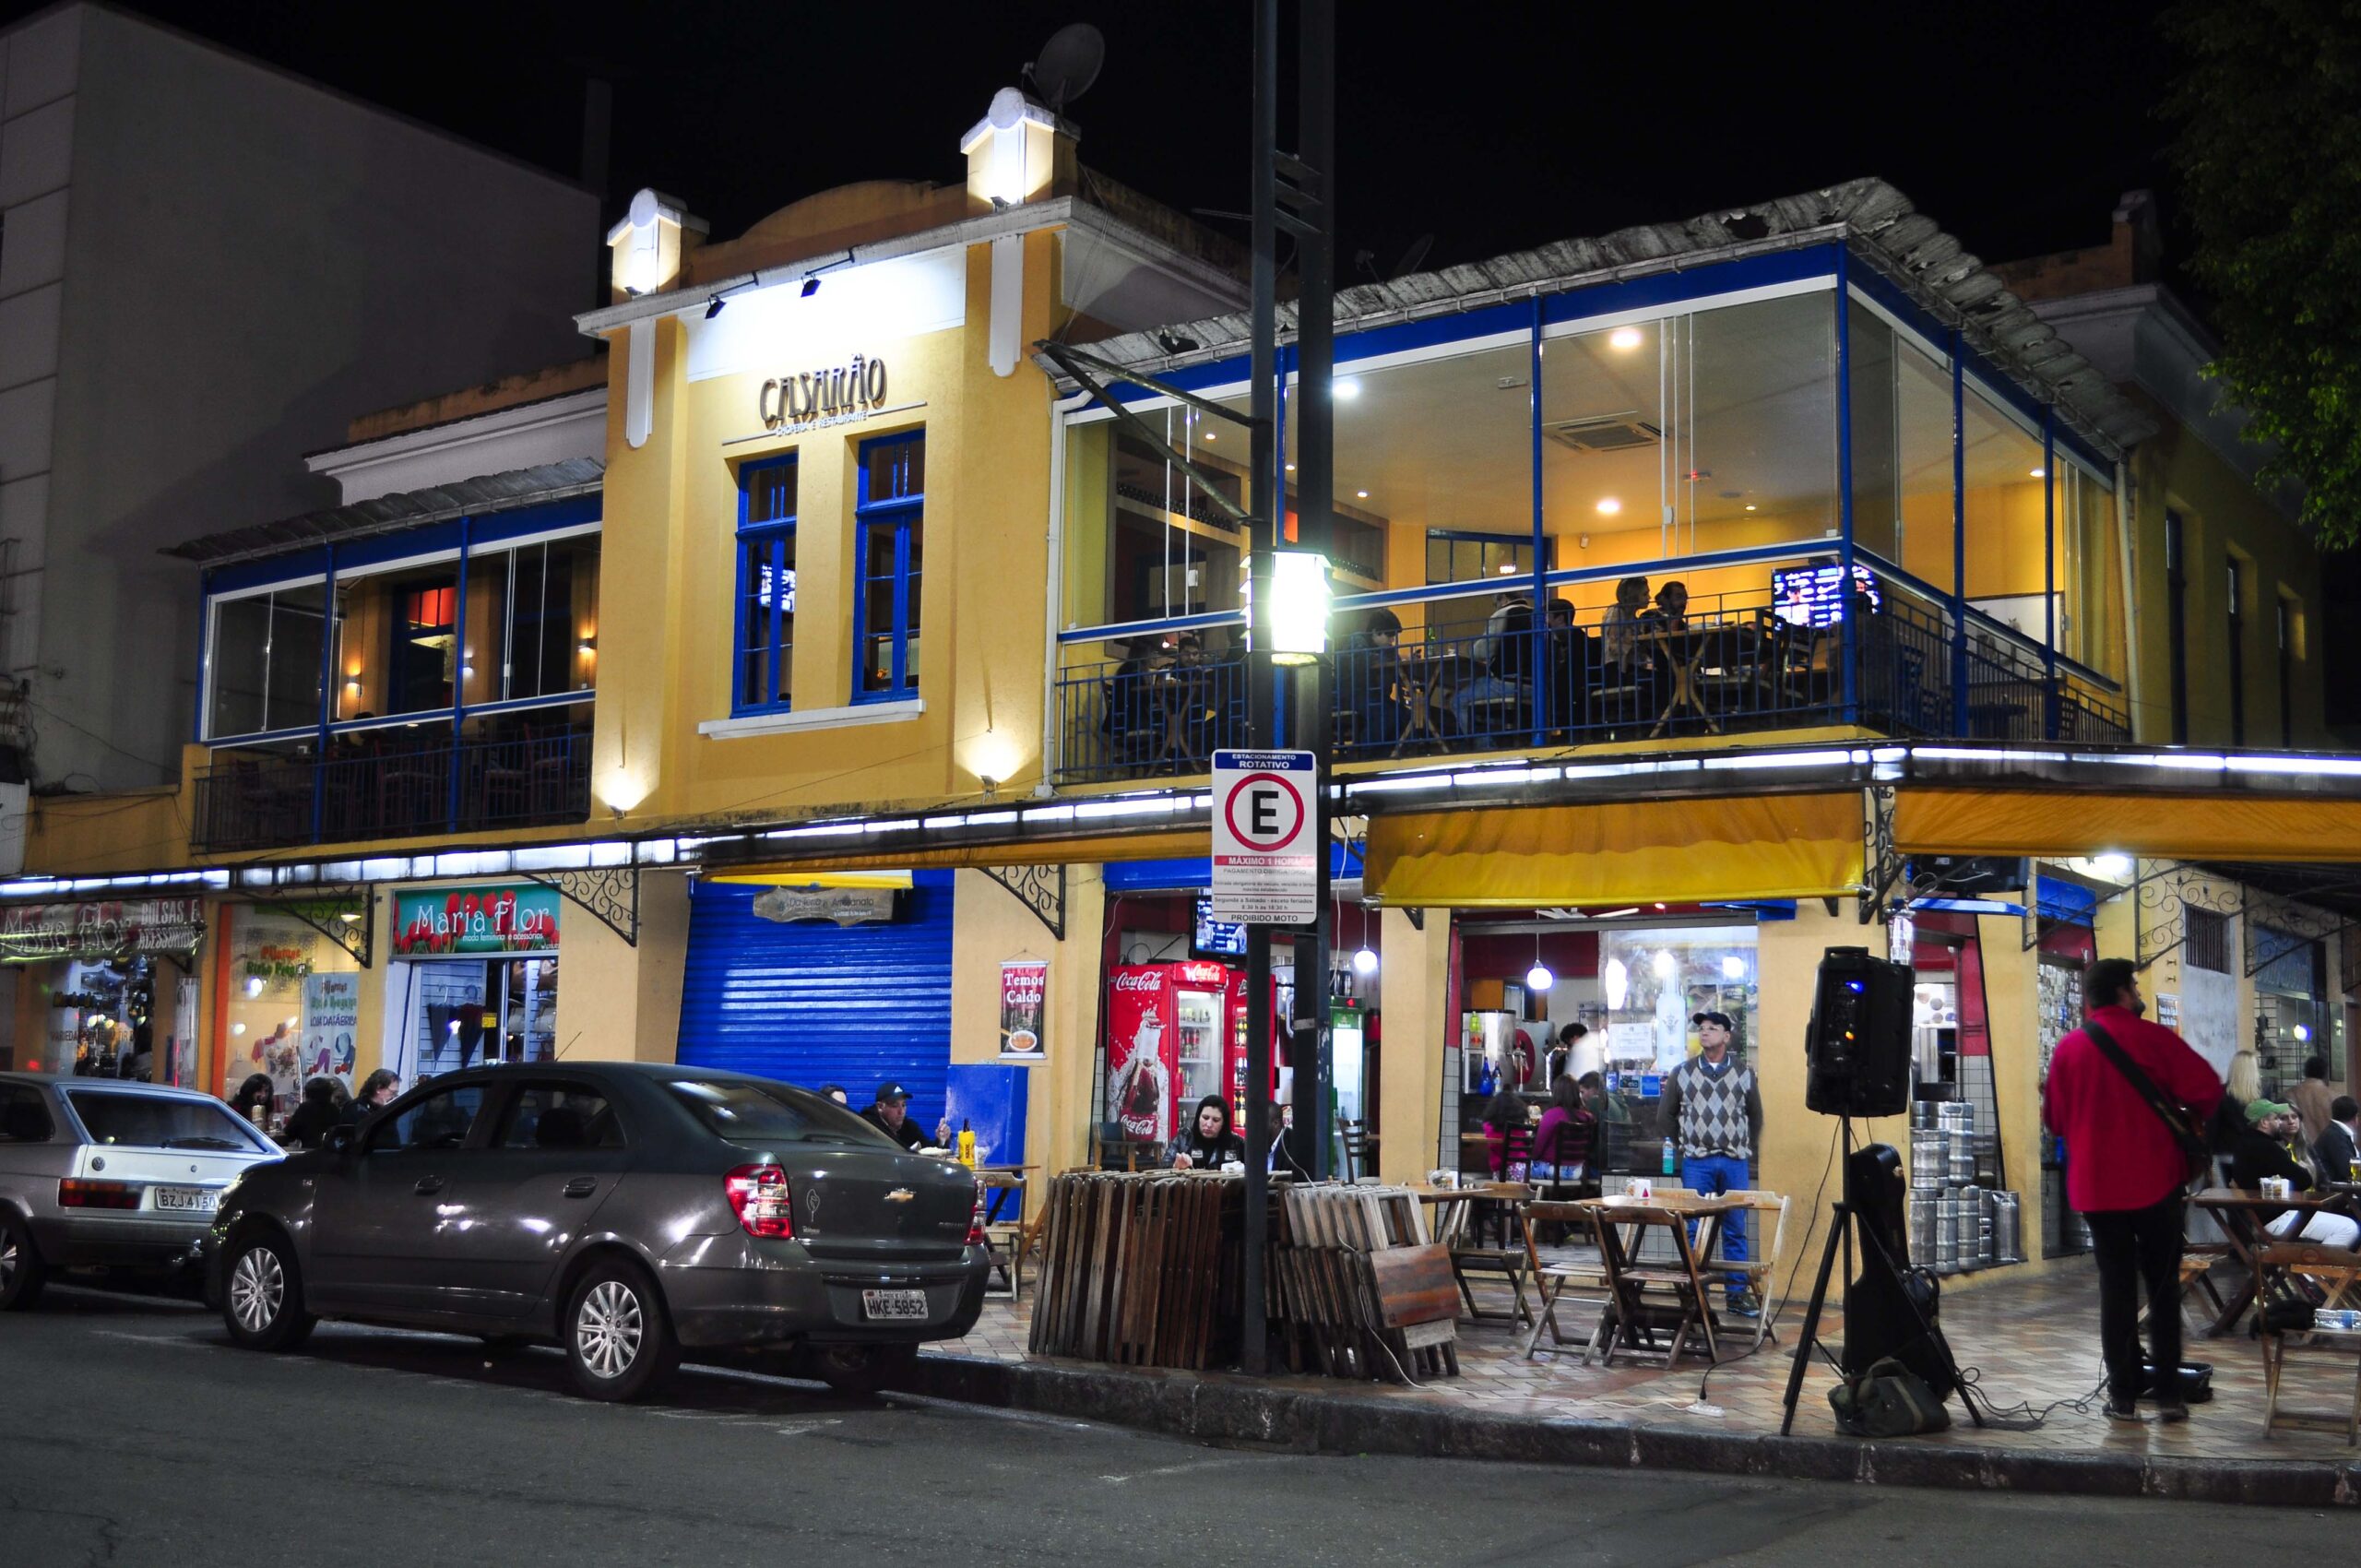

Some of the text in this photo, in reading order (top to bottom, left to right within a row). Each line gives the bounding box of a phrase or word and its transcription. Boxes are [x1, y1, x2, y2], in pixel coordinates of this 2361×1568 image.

[760, 353, 887, 423] CASARÃO
[1239, 761, 1289, 769] ROTATIVO
[1252, 790, 1279, 834] E
[1228, 856, 1265, 865] MÁXIMO
[141, 899, 198, 925] BOLSAS E
[416, 899, 549, 934] Maria Flor
[463, 932, 480, 942] moda
[481, 932, 505, 941] feminina
[1004, 973, 1044, 986] Temos
[1116, 971, 1163, 992] Coca-Cola
[1006, 990, 1041, 1004] Caldo
[310, 1016, 323, 1027] LOJA
[1121, 1114, 1154, 1134] Coca-Cola
